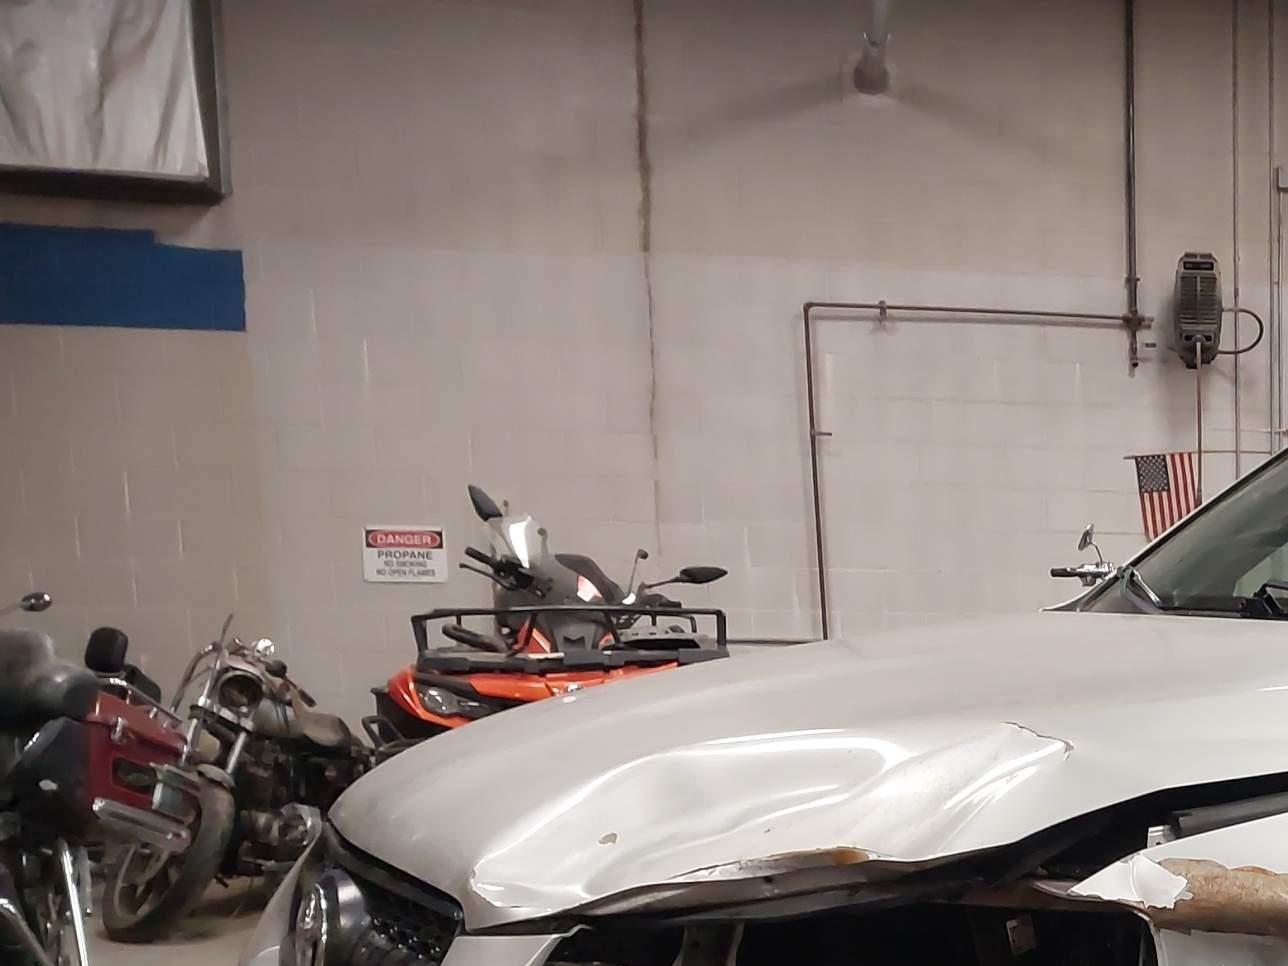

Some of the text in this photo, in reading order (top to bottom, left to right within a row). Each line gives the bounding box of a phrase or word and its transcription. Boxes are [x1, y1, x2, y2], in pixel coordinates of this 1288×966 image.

[377, 533, 432, 545] DANGER
[377, 550, 433, 560] PROPANE
[396, 560, 427, 568] SMOKING
[376, 568, 436, 577] NO OPEN FLAMES
